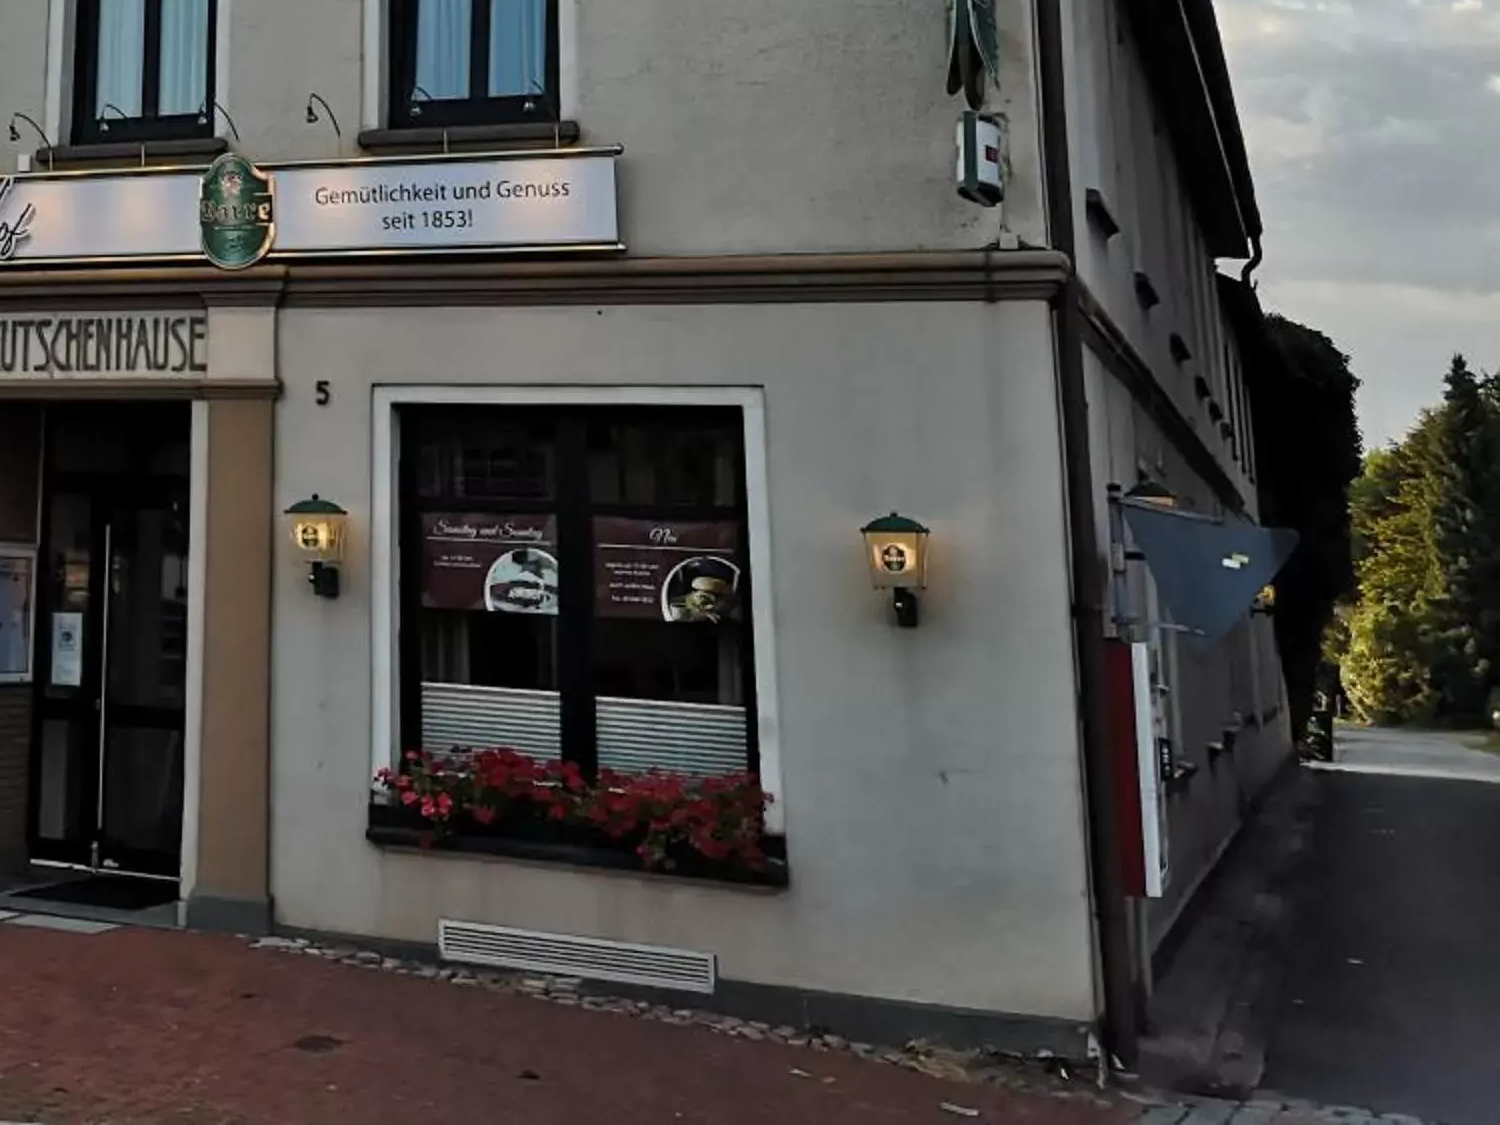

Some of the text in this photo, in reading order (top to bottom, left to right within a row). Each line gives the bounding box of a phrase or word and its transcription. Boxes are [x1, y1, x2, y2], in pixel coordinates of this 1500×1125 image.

[315, 179, 570, 205] Gemütlichkeit und Genuss
[382, 209, 473, 230] seit 1853!
[114, 316, 208, 373] HAUSE
[315, 380, 330, 406] 5
